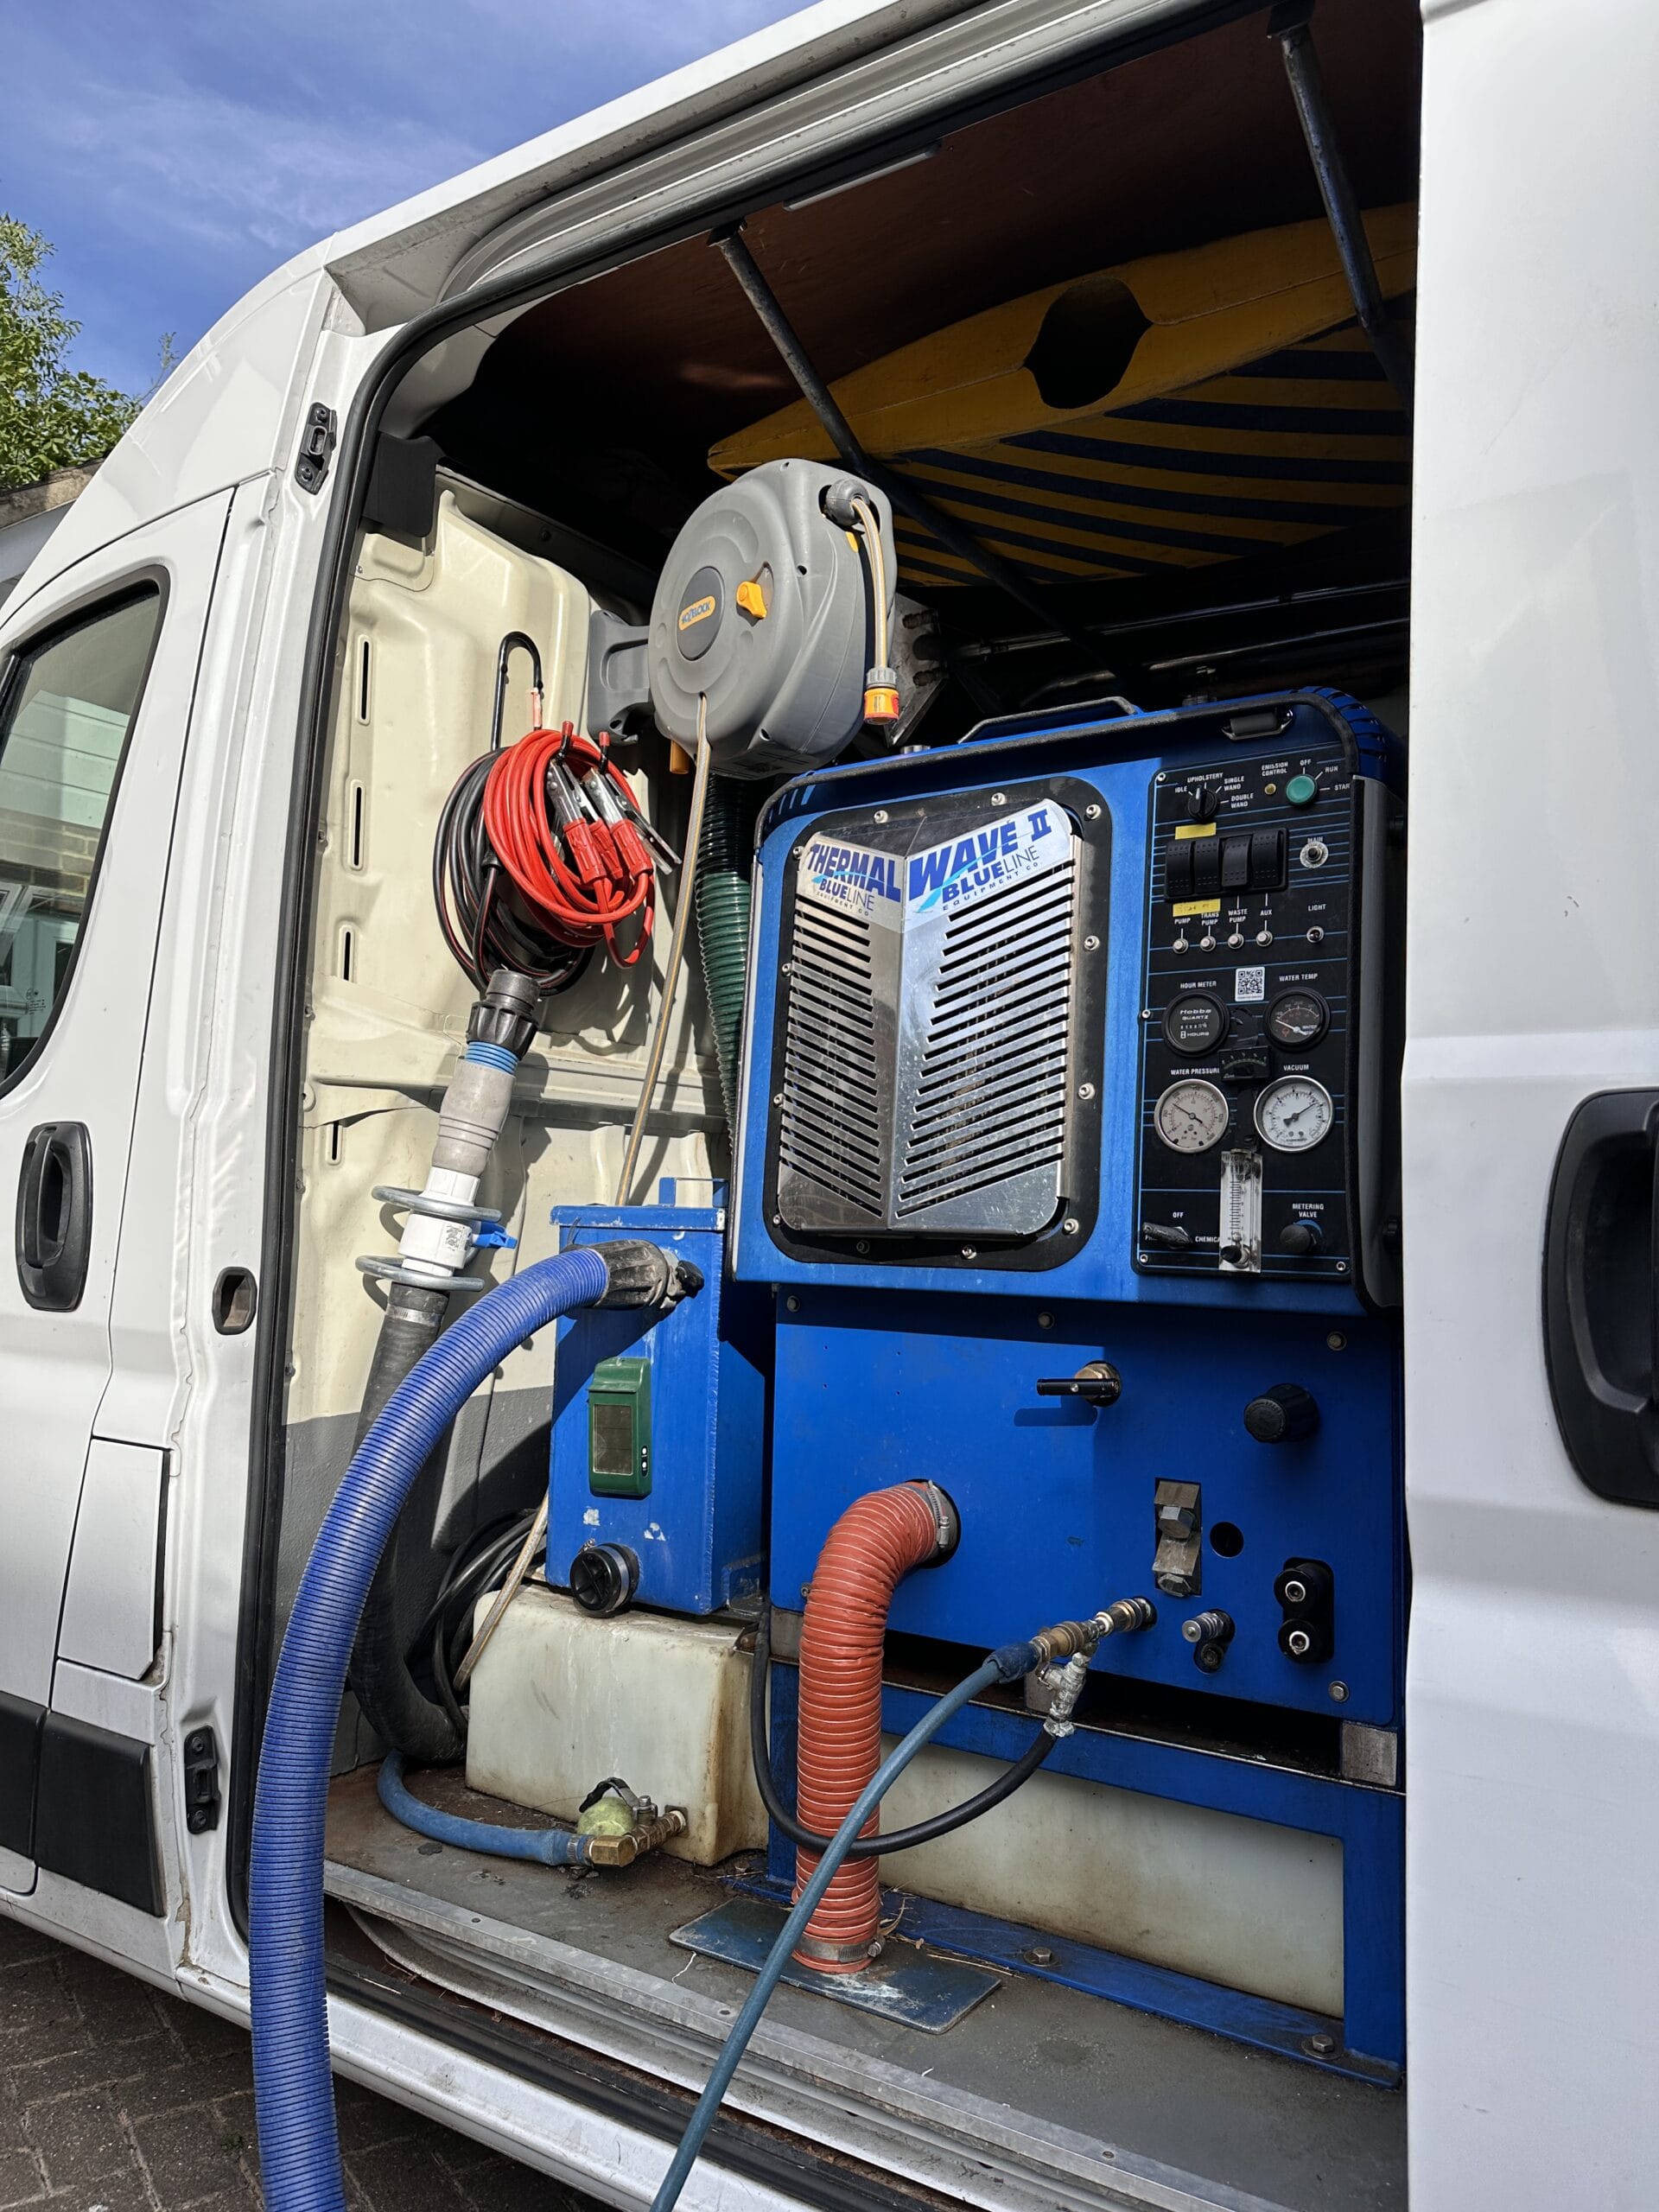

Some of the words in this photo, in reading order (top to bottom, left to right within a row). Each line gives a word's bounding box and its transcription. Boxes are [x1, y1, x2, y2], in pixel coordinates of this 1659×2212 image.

[1262, 761, 1289, 771] EMISSION
[1262, 768, 1288, 777] CONTROL
[1187, 772, 1224, 783] UPHOLSTERY
[1224, 776, 1245, 785] SINGLE
[1230, 793, 1255, 802] DOUBLE
[1230, 801, 1249, 810] WAND
[908, 821, 1019, 901] WAVE
[807, 843, 902, 903] THERMAL
[942, 845, 1039, 904] BLUELINE
[819, 878, 875, 912] BLUELINE
[943, 871, 1019, 911] EQUIPMENT
[816, 891, 854, 910] EQUIPMENT
